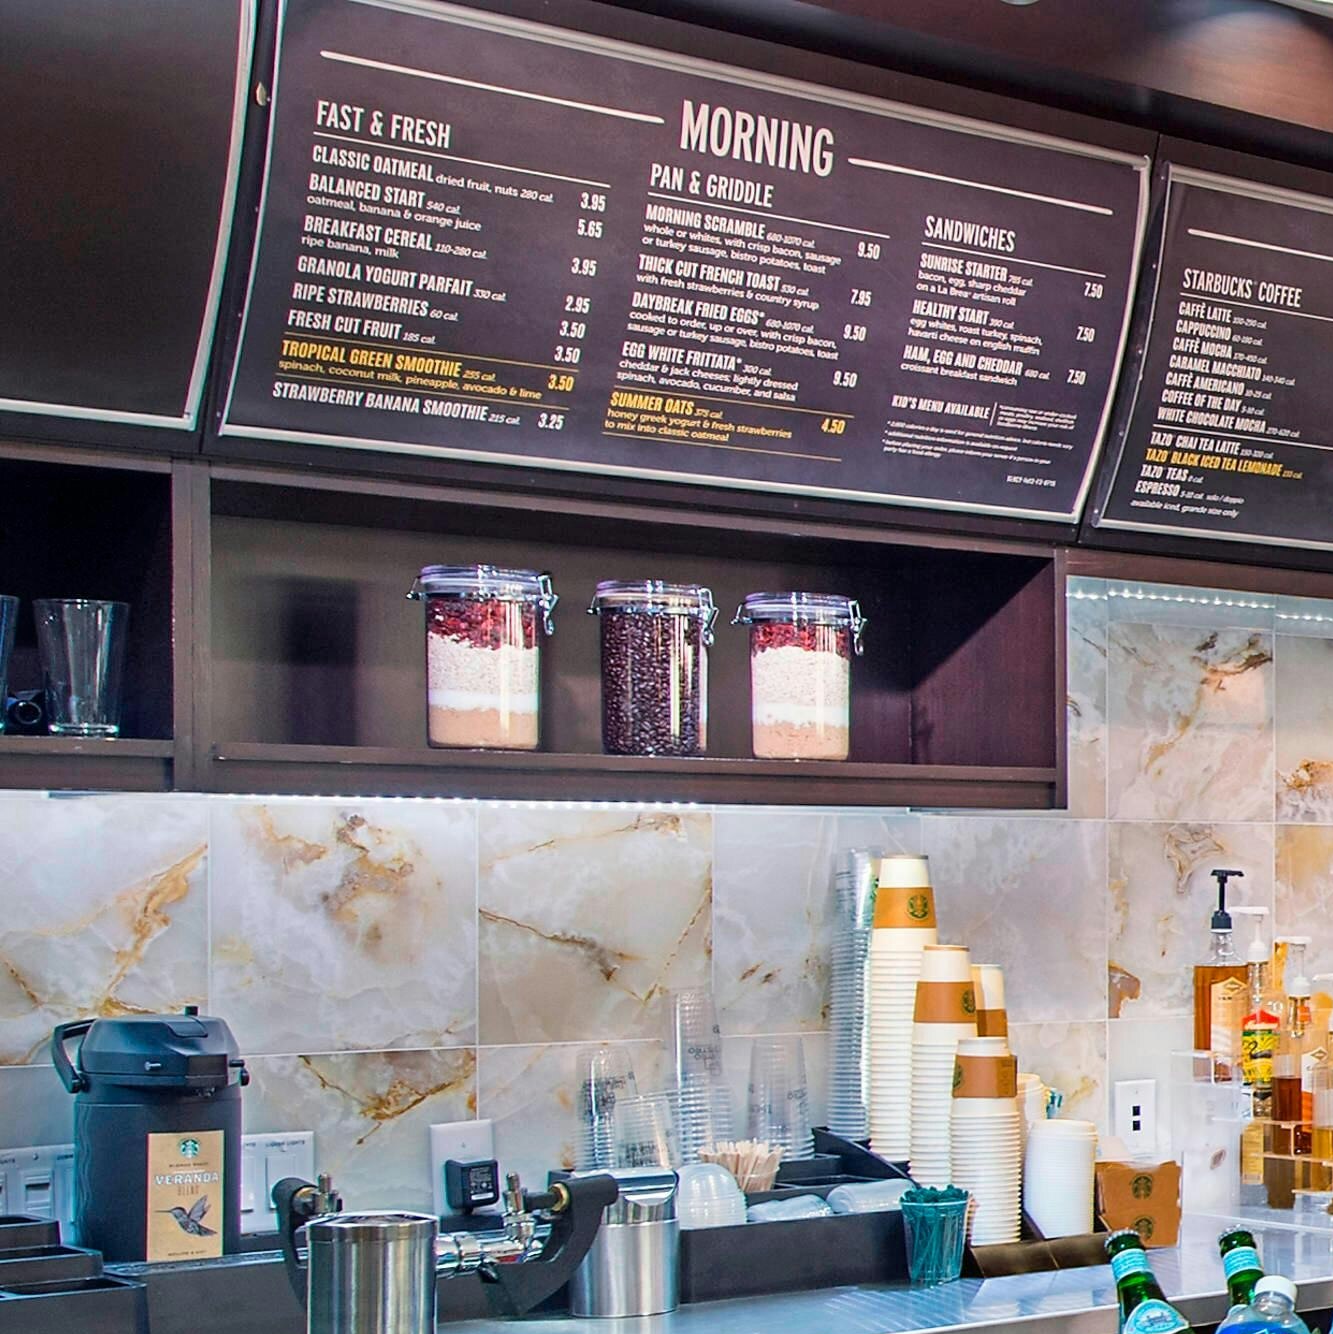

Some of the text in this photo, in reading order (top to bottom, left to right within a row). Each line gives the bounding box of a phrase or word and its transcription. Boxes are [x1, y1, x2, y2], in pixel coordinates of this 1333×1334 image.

[316, 101, 450, 147] FAST & FRESH
[681, 99, 834, 177] MORNING
[312, 145, 606, 210] CLASSIC OATMEAL dried fruit, nuts 3.95
[649, 164, 774, 207] PAN & GRIDDLE
[307, 194, 355, 210] oatmeal,
[359, 203, 401, 217] banana
[414, 212, 452, 228] orange
[454, 218, 481, 232] juice
[309, 174, 602, 237] BALANCED START 5.65
[304, 215, 596, 275] BREAKFAST CEREAL 3.95
[645, 205, 880, 258] MORNING SCRAMBLE 9.50
[924, 216, 1016, 251] SANDWICHES
[297, 256, 589, 312] GRANOLA YOGURT PARFAIT 2.95
[636, 273, 658, 283] with
[660, 277, 684, 287] fresh
[686, 281, 744, 297] strawberries
[754, 293, 791, 306] country
[792, 299, 818, 310] syrup
[638, 255, 872, 306] THICK CUT FRENCH TOAST 7.95
[920, 253, 1102, 298] SUNRISE STARTER 7.50
[1257, 282, 1302, 306] COFFEE
[293, 283, 584, 337] RIPE STRAWBERRIES 3.50
[632, 292, 693, 314] DAYBREAK
[695, 302, 728, 319] FRIED
[843, 324, 866, 341] 9.50
[913, 300, 1094, 341] HEALTHY START 7.50
[1176, 320, 1230, 339] CAPPUCCINO
[1206, 306, 1232, 322] LATTE
[288, 310, 579, 362] FRESH CUT FRUIT 3.50
[1200, 342, 1232, 358] MOCHA
[281, 340, 573, 391] TROPICAL GREEN SMOOTHIE 3.50
[329, 366, 374, 379] coconut
[463, 382, 506, 395] avocado
[519, 389, 541, 399] lime
[622, 341, 645, 358] EGG
[648, 345, 684, 363] WHITE
[833, 371, 856, 387] 9.50
[903, 345, 1085, 385] HAM, EGG AND CHEDDAR 7.50
[1169, 355, 1261, 379] CARAMEL MACCHIATO
[1161, 390, 1192, 405] COFFEE
[1206, 396, 1222, 409] THE
[1223, 398, 1241, 412] DAY
[1194, 377, 1244, 394] AMERICANO
[273, 383, 563, 429] STRAWBERRY BANANA SMOOTHIE 3.25
[610, 392, 845, 434] SUMMER OATS 4.50
[945, 402, 988, 418] AVAILABLE
[1157, 407, 1266, 432] WHITE CHOCOLATE MOCHA
[1171, 451, 1199, 465] BLACK
[1200, 455, 1220, 468] ICED
[1221, 458, 1237, 470] TEA
[1238, 460, 1282, 475] LEMONADE
[1175, 435, 1197, 448] CHAI
[1198, 438, 1214, 450] TEA
[1215, 440, 1240, 453] LATTE
[1135, 481, 1180, 496] ESPRESSO
[1166, 467, 1188, 480] TEAS
[155, 1172, 219, 1185] VERANDA
